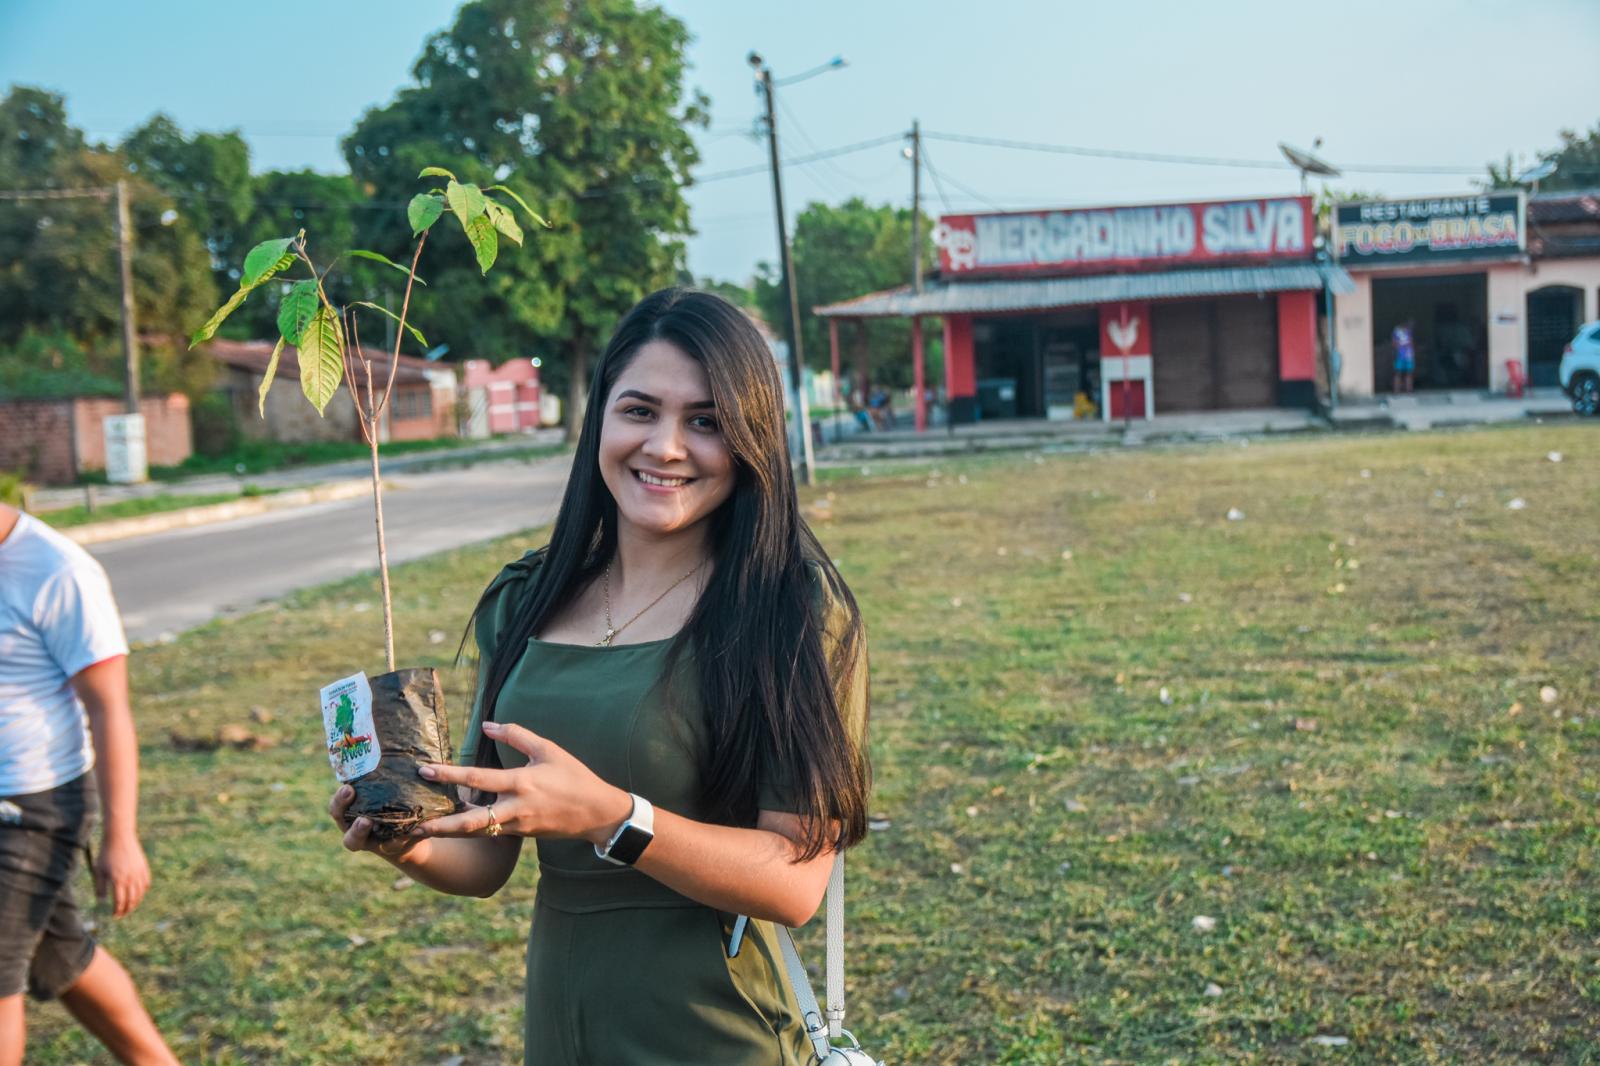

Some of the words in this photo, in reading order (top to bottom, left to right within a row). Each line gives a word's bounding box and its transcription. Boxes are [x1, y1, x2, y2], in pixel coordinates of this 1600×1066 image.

[1361, 198, 1490, 220] RESTAURANTE
[974, 205, 1197, 264] MERCADINHO
[1202, 199, 1306, 253] SILVA
[1337, 222, 1415, 256] FOGO
[1429, 212, 1519, 251] BRASA
